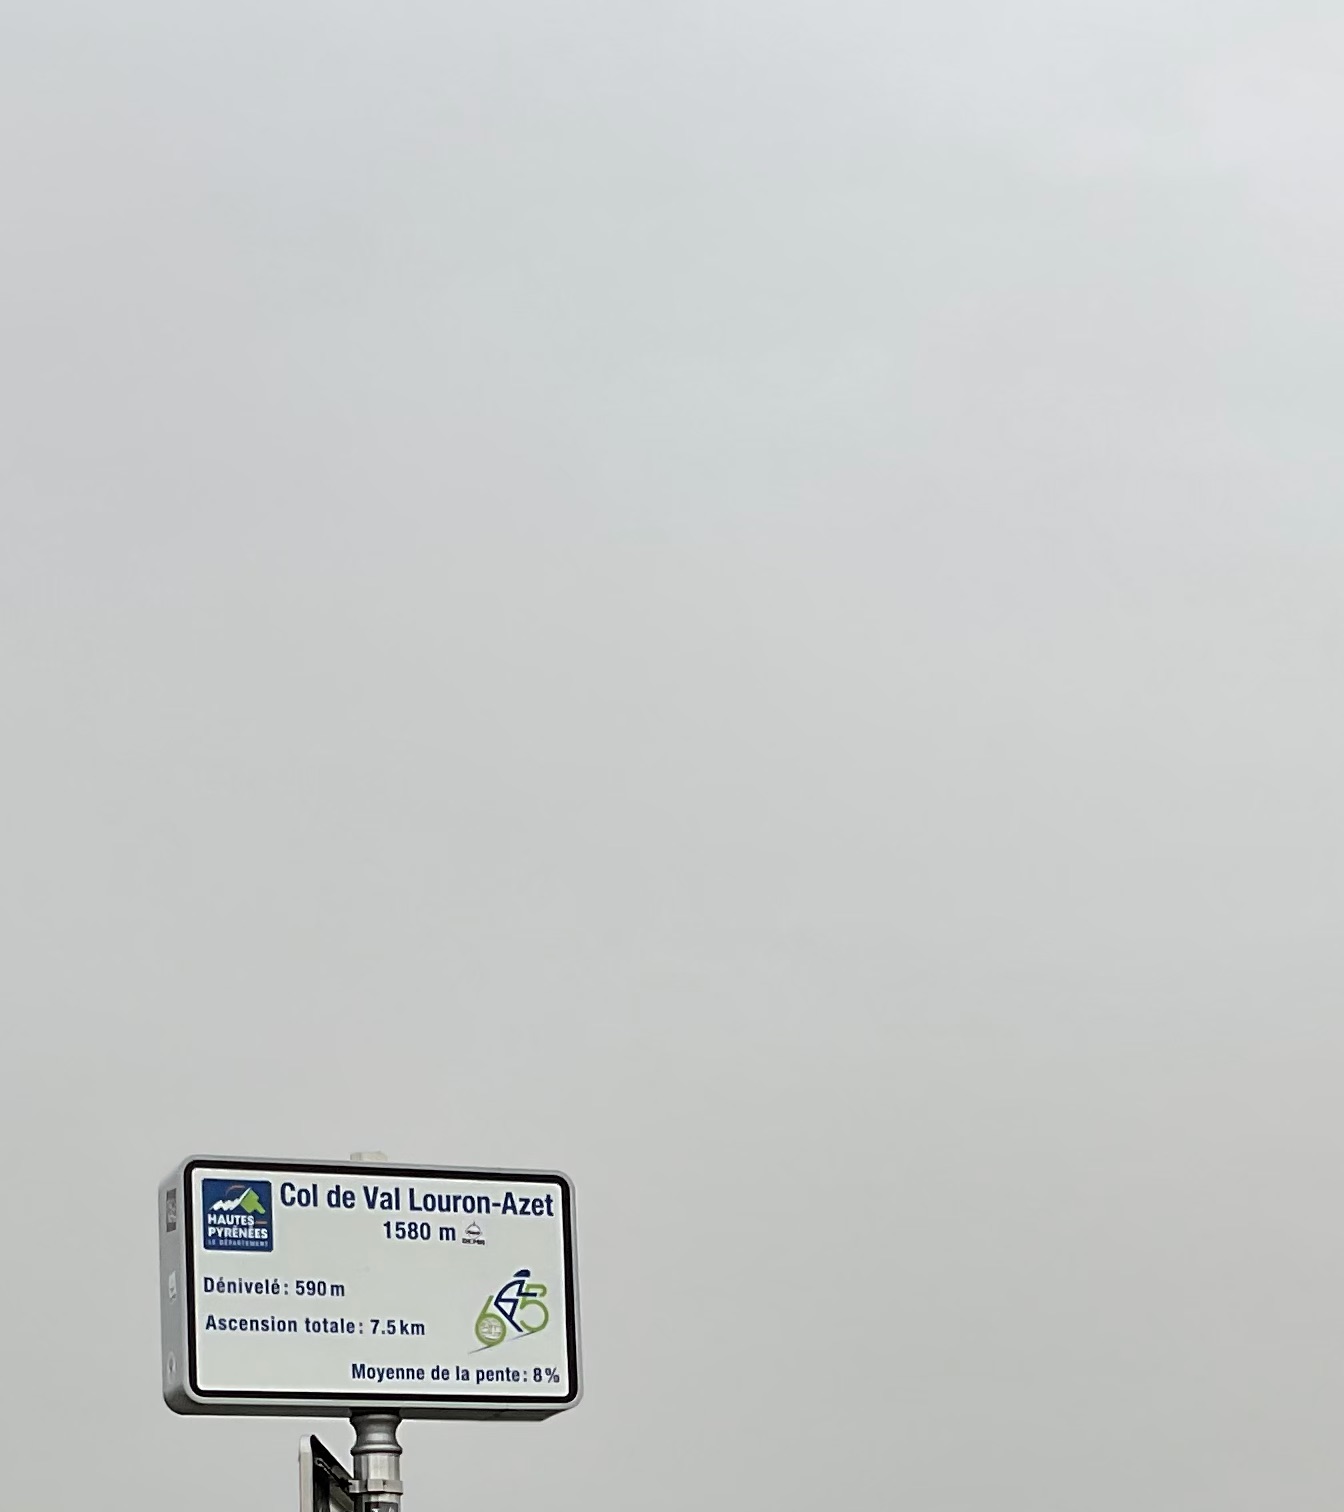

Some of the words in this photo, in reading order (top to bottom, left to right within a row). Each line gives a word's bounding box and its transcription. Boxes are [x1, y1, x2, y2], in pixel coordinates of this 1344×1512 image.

[280, 1182, 319, 1209] Col
[327, 1184, 356, 1210] de
[363, 1186, 401, 1212] Val
[409, 1188, 555, 1217] Louron-Azet
[207, 1213, 255, 1226] HAUTES
[207, 1224, 269, 1239] PYRÉNÉES
[383, 1220, 431, 1241] 1580
[438, 1225, 456, 1242] m
[205, 1314, 296, 1333] Ascension
[351, 1363, 425, 1383] Moyenne
[430, 1365, 449, 1382] de
[454, 1366, 470, 1382] la
